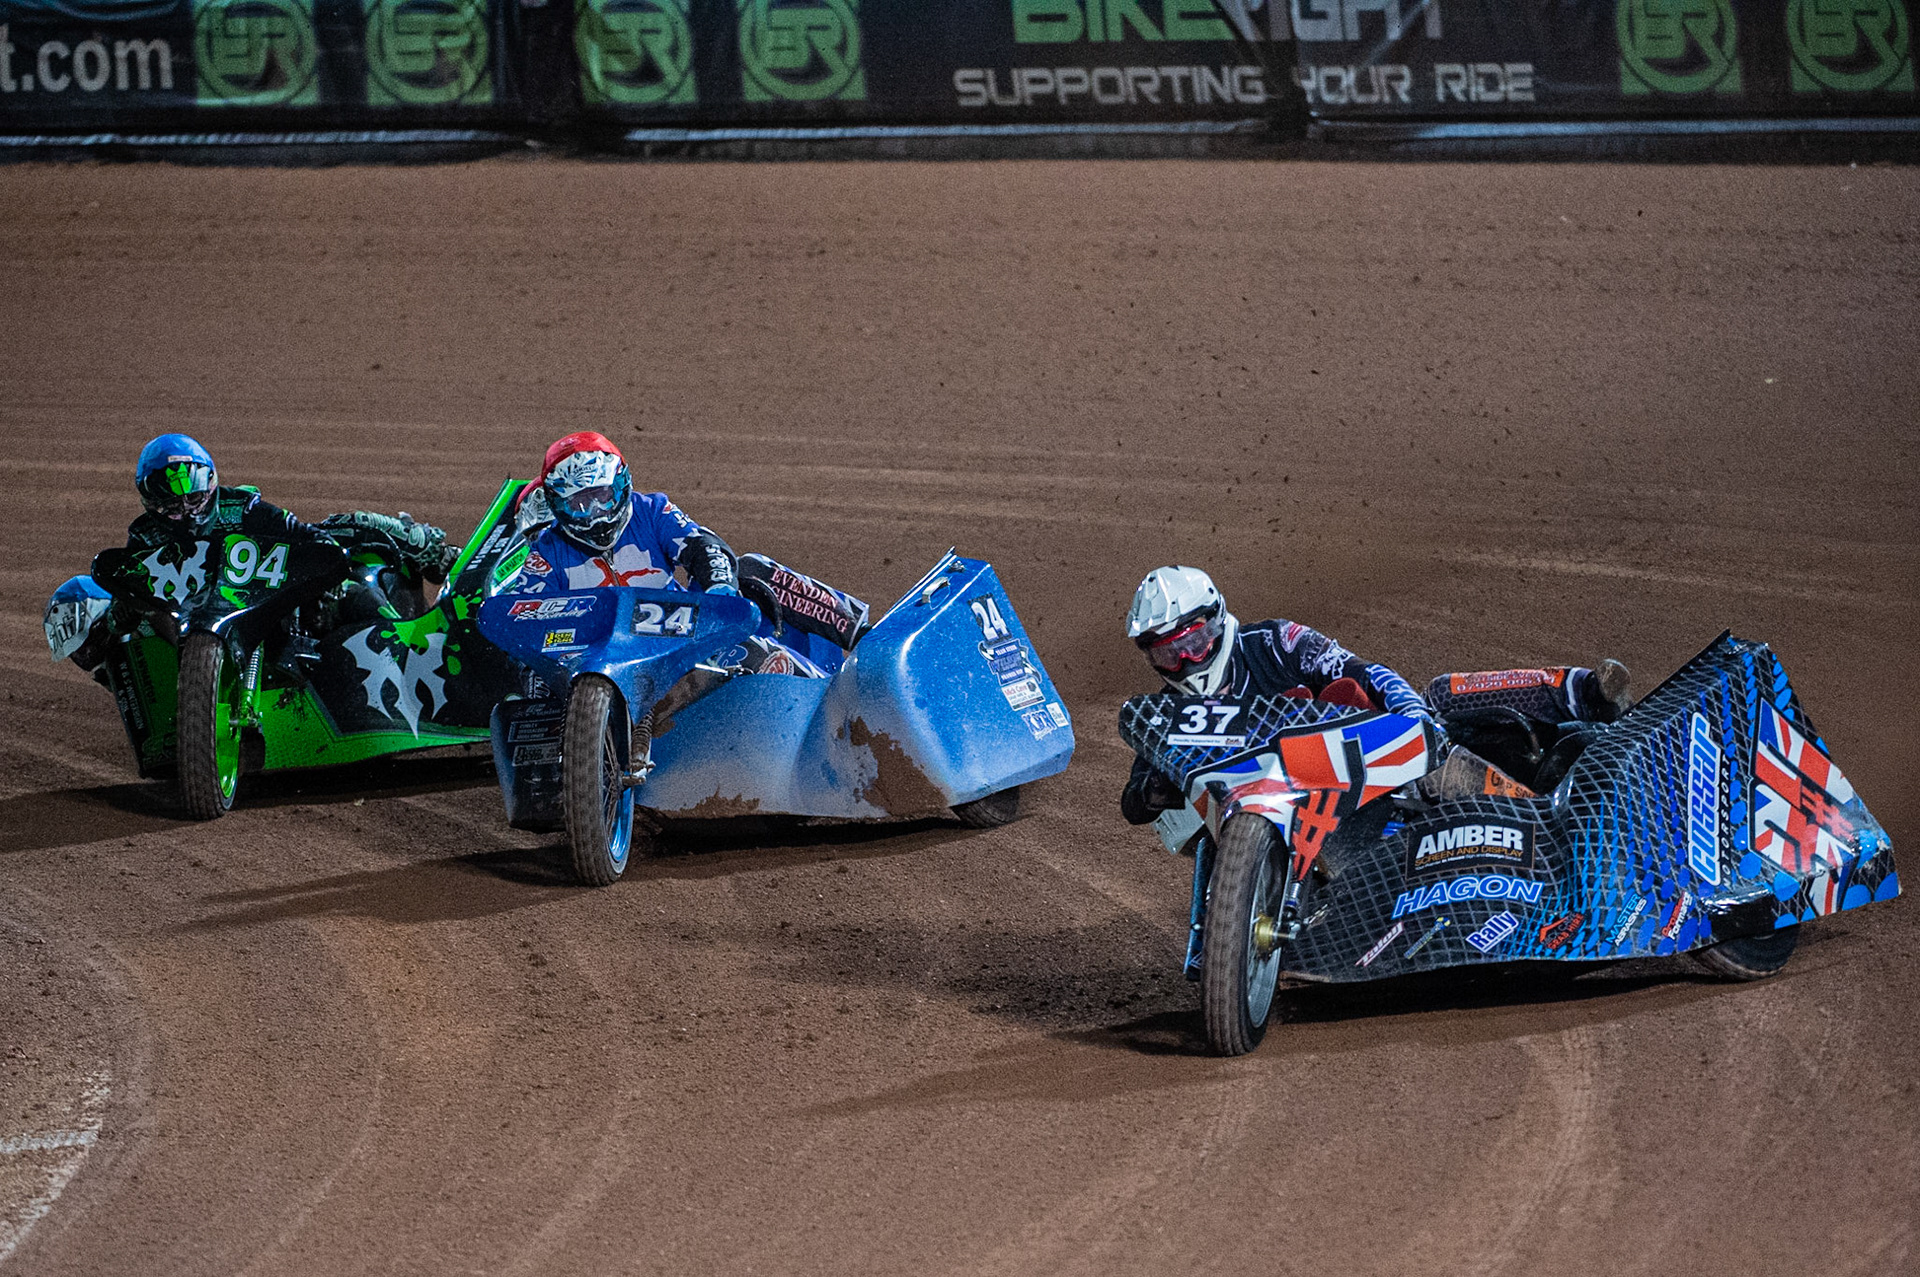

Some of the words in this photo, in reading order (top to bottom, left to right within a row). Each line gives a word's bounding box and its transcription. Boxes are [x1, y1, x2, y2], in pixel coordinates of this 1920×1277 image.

[953, 66, 1265, 107] SUPPORTING
[1295, 65, 1412, 103] YOUR
[1436, 63, 1535, 102] RIDE
[225, 540, 288, 588] 94
[771, 568, 838, 608] EVENDEN
[771, 586, 848, 633] GINEERING
[635, 603, 693, 636] 24
[971, 598, 1009, 640] 24
[1179, 705, 1240, 734] 37
[1416, 825, 1524, 859] AMBER
[1721, 754, 1731, 888] MOTORSPORT
[1415, 850, 1455, 867] SCREEN
[1456, 846, 1479, 857] AND
[1481, 845, 1524, 858] DISPLAY
[1391, 875, 1544, 919] HAGON
[1605, 893, 1641, 944] MASTER
[1468, 911, 1518, 949] Rally
[1614, 897, 1648, 947] ABRASIVES
